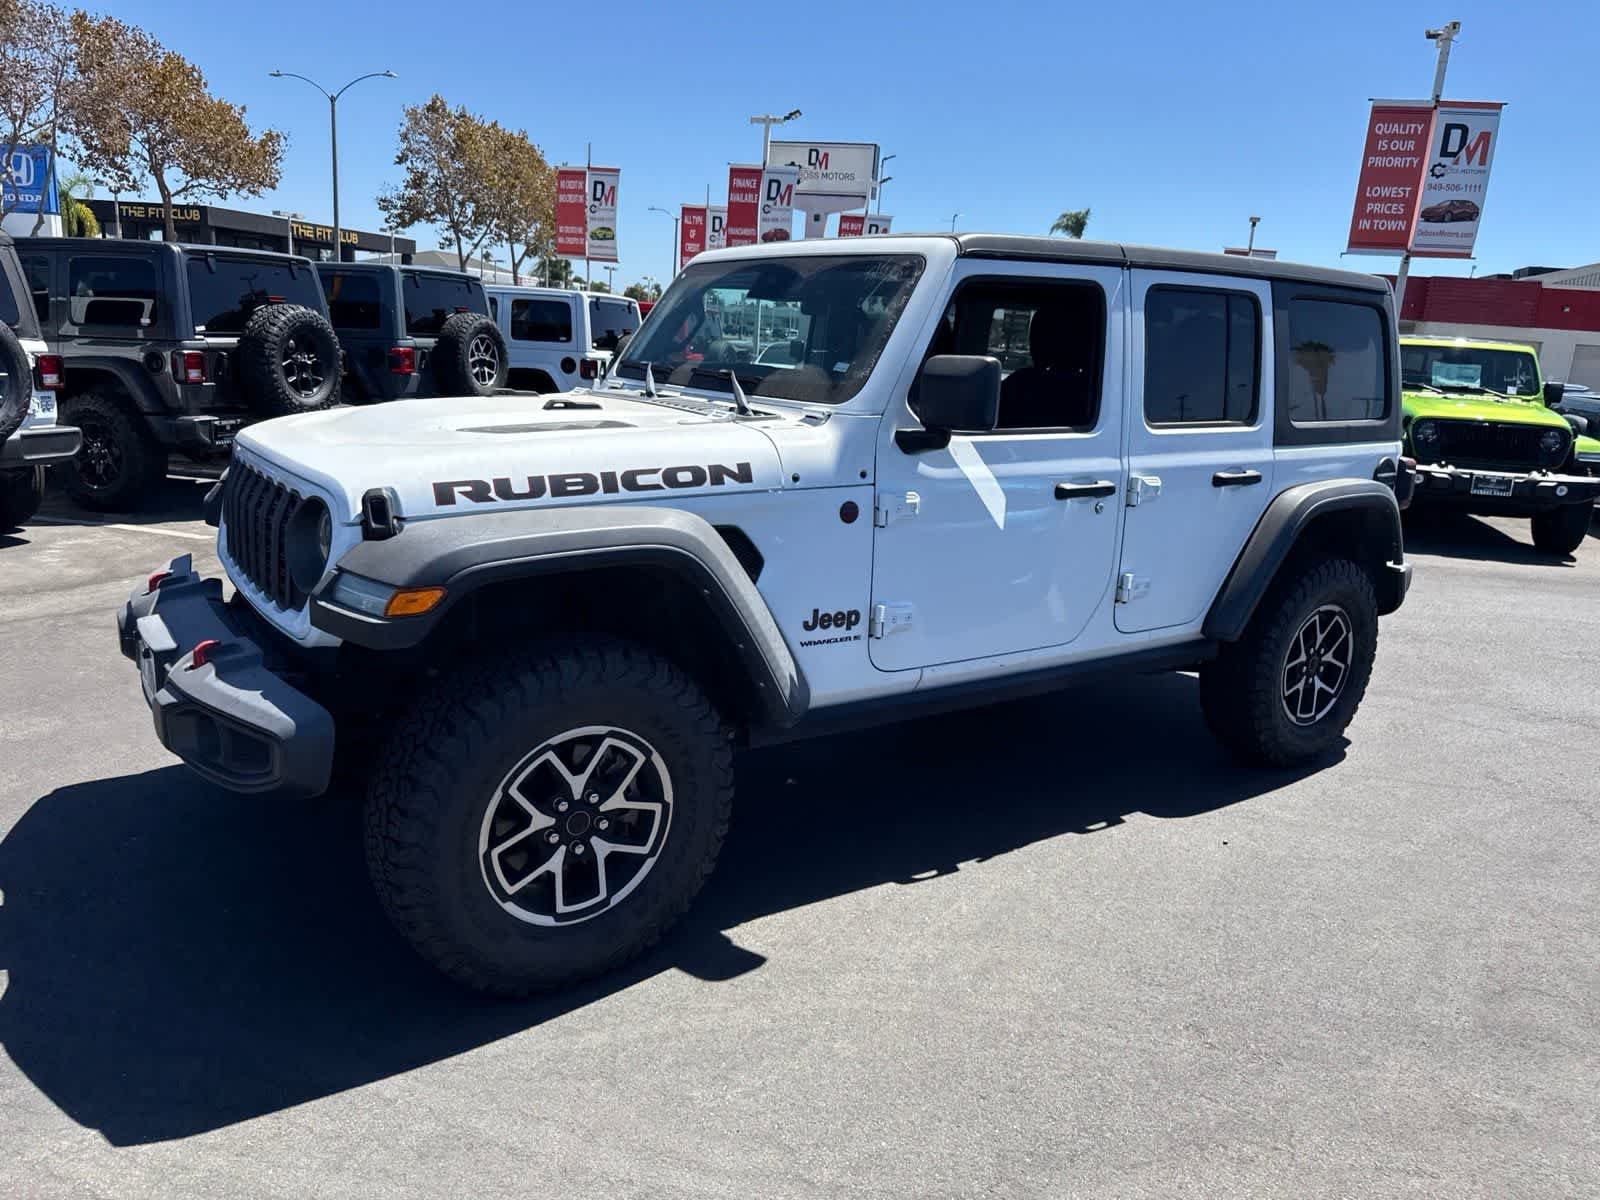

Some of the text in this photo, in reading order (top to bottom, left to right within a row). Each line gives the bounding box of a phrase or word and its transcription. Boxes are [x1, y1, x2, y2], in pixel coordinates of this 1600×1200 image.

[1375, 123, 1424, 134] QUALITY
[1378, 140, 1415, 151] IS OUR
[1368, 156, 1420, 168] PRIORITY
[821, 172, 855, 181] MOTORS
[732, 178, 757, 188] FINANCE
[729, 192, 759, 203] AVAILABLE
[1366, 186, 1412, 198] LOWEST
[119, 205, 201, 221] THE FIT CLUB
[1366, 203, 1405, 214] PRICES
[1358, 219, 1407, 231] IN TOWN
[291, 223, 359, 244] THE FIT LUB
[432, 462, 753, 506] RUBICON
[802, 608, 860, 631] Jeep
[800, 635, 852, 648] WRANGLER
